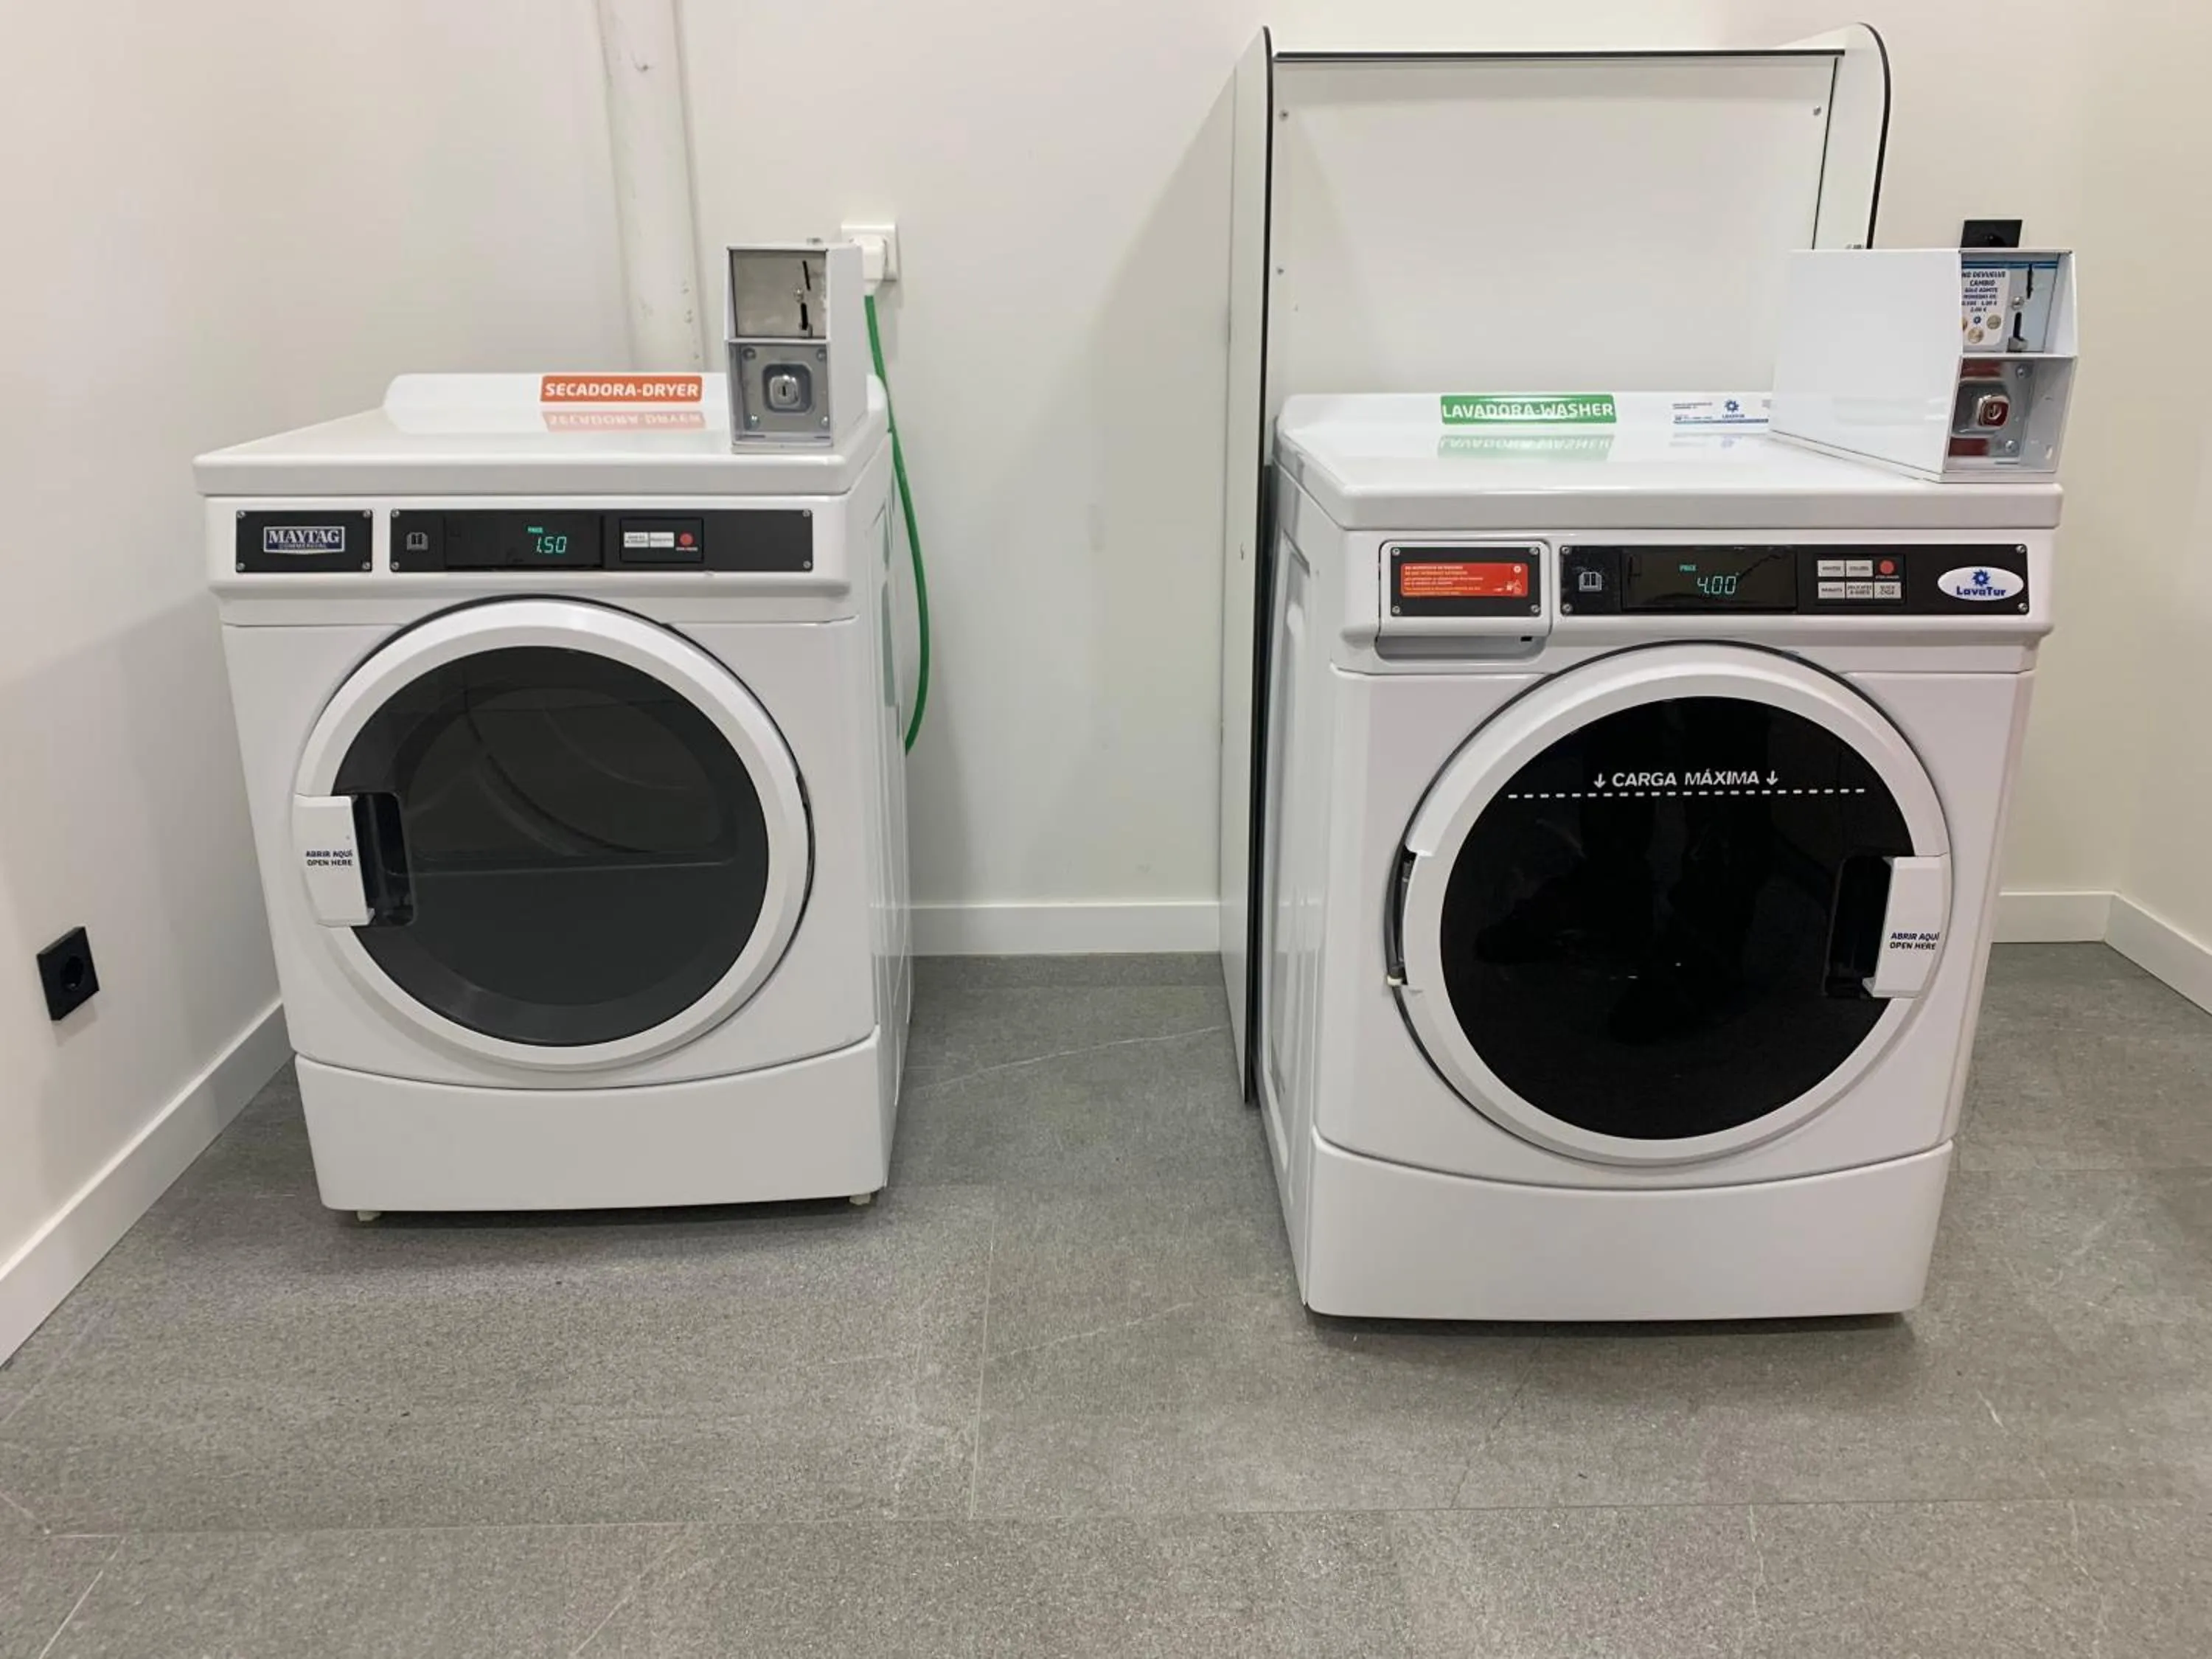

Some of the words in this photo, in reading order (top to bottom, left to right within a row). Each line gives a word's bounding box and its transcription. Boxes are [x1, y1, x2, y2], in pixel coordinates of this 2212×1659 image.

[268, 530, 340, 543] MAYTAG
[536, 536, 567, 554] 1.50
[1697, 575, 1736, 595] 4.00
[1956, 585, 2006, 596] LavaTur
[1612, 772, 1677, 787] CARGA
[1684, 768, 1760, 786] MÁXIMA
[1891, 932, 1917, 940] ABRIR
[1890, 942, 1913, 950] OPEN
[1914, 942, 1936, 950] HERE
